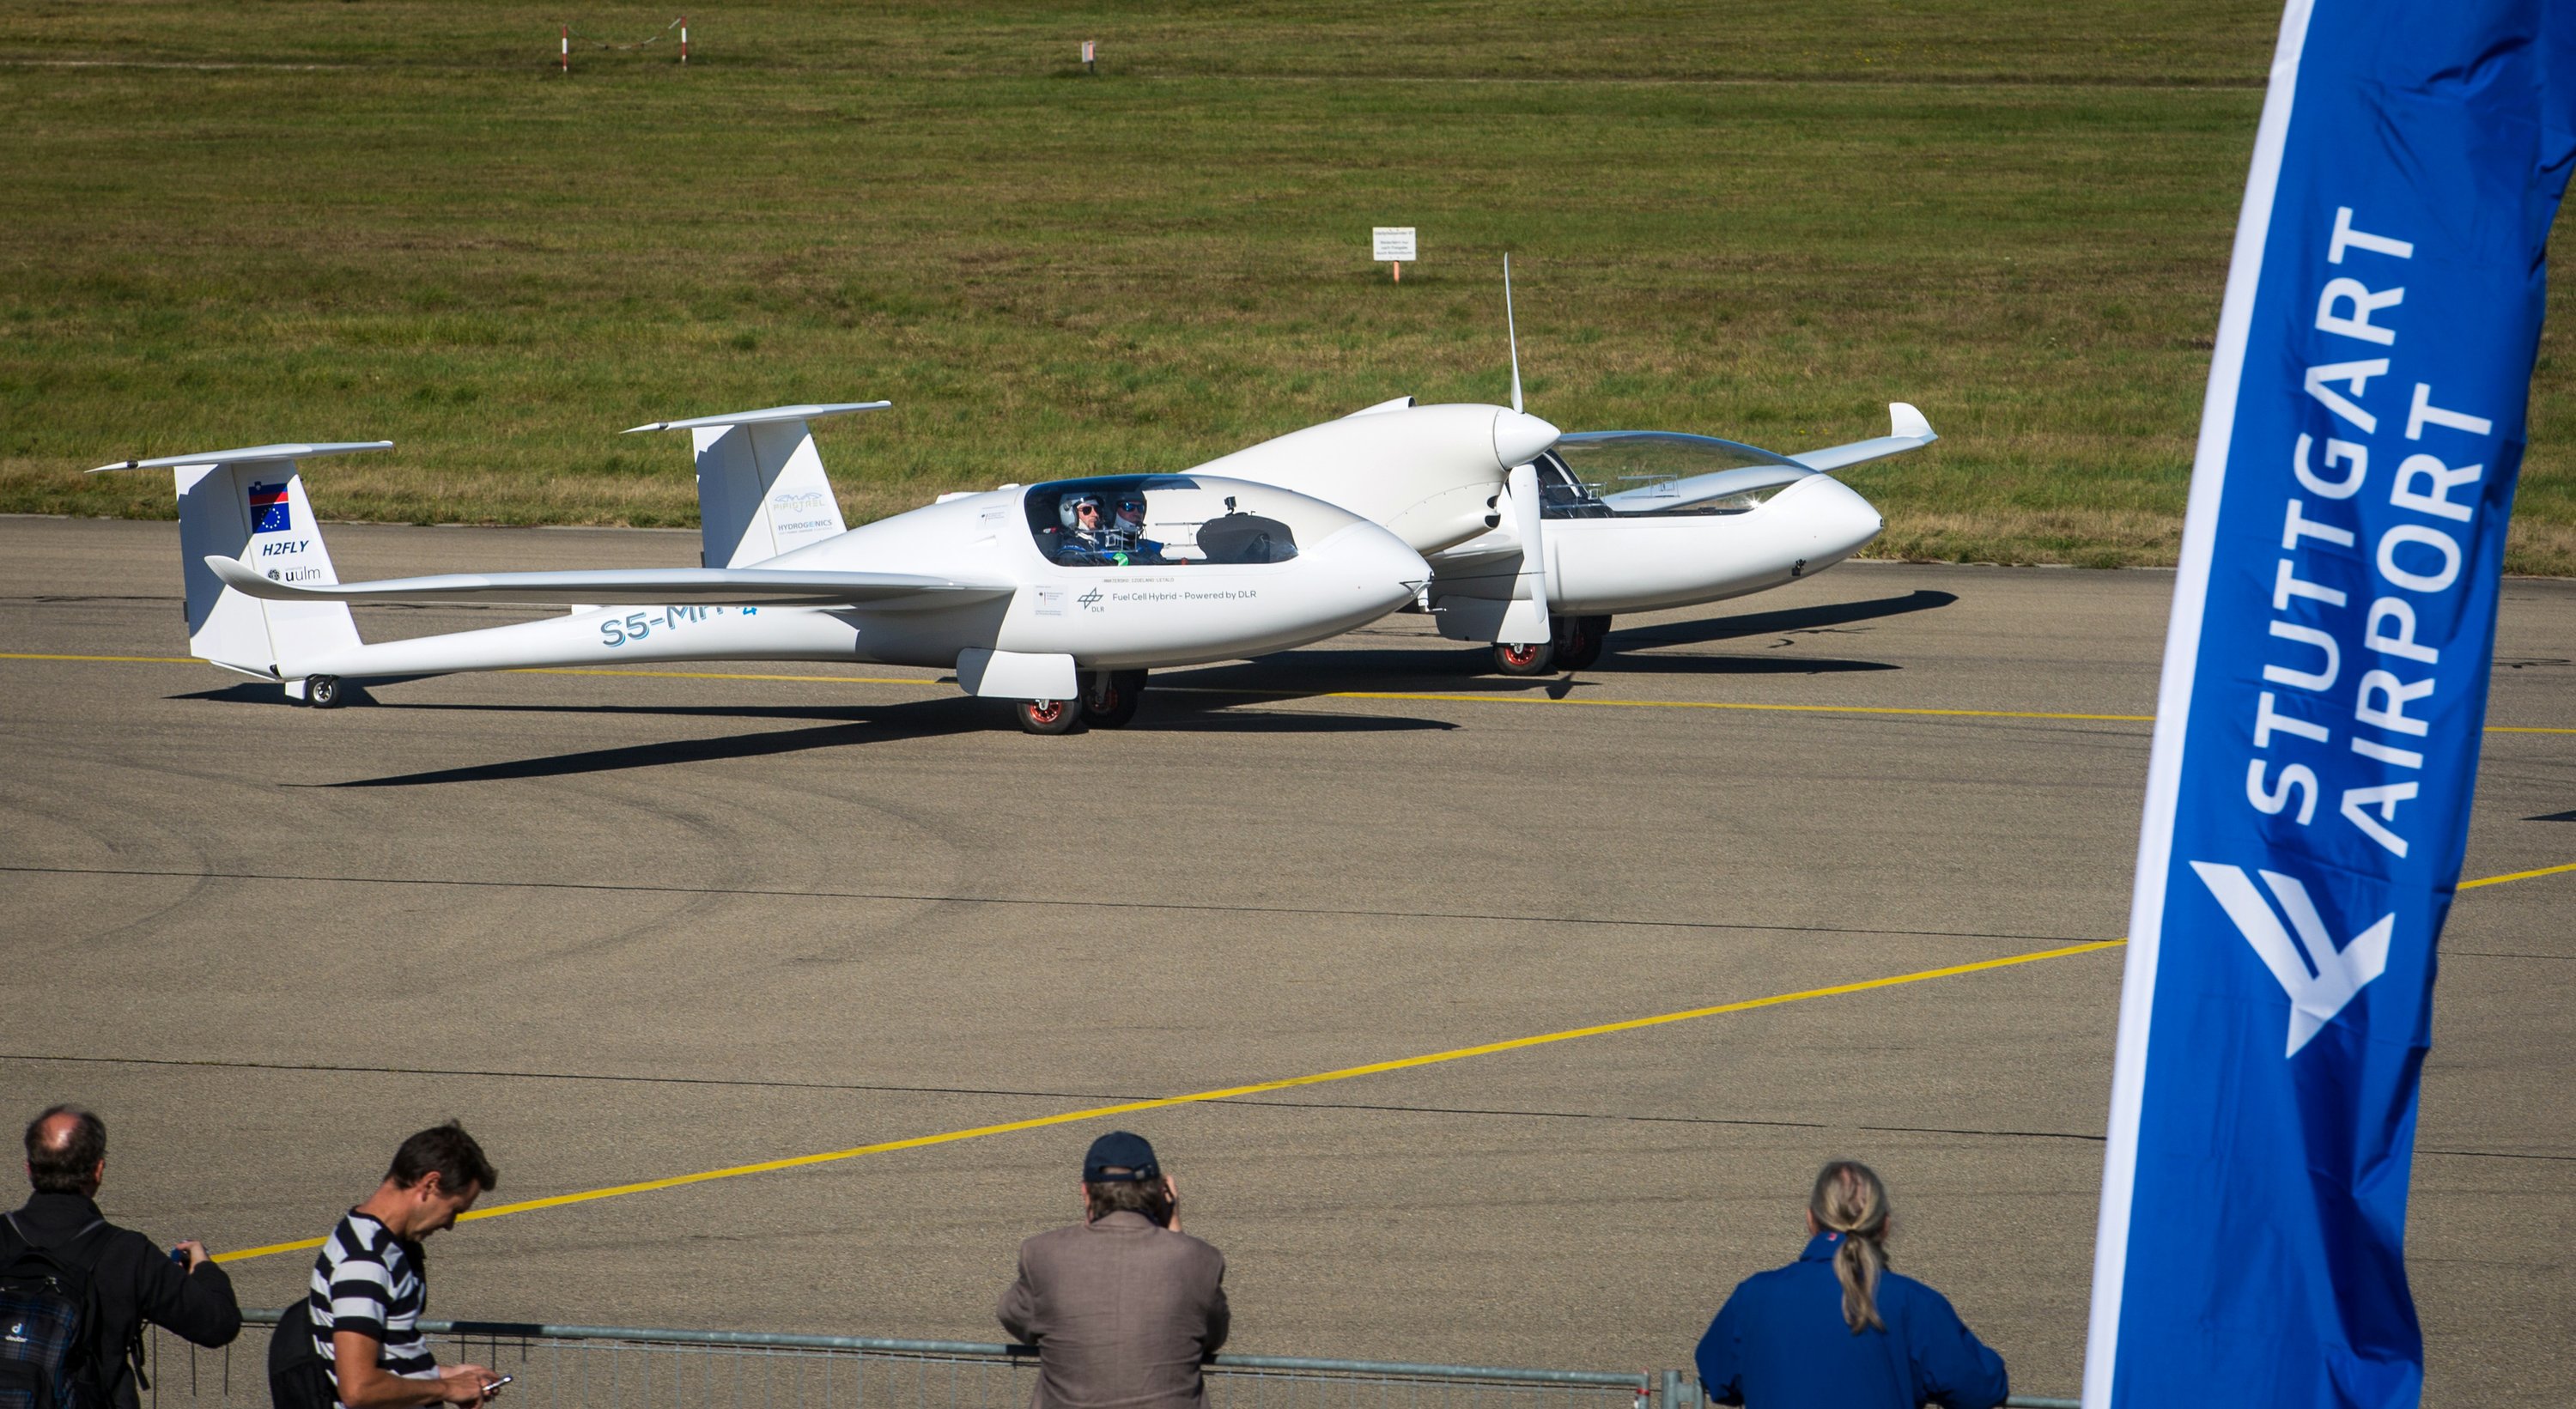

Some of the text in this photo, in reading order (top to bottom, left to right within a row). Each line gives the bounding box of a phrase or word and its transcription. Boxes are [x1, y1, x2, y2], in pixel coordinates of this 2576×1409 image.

[778, 519, 832, 531] HYDROGENICS
[2246, 206, 2415, 827] STUTTGART
[262, 539, 309, 557] H2FLY
[285, 565, 321, 582] uulm
[1112, 592, 1131, 601] Fuel
[1132, 592, 1148, 601] Cell
[1149, 592, 1177, 602] Hybrid
[1184, 591, 1224, 600] Powered
[1225, 591, 1236, 601] by
[1237, 590, 1257, 598] DLR
[2341, 383, 2493, 859] AIRPORT
